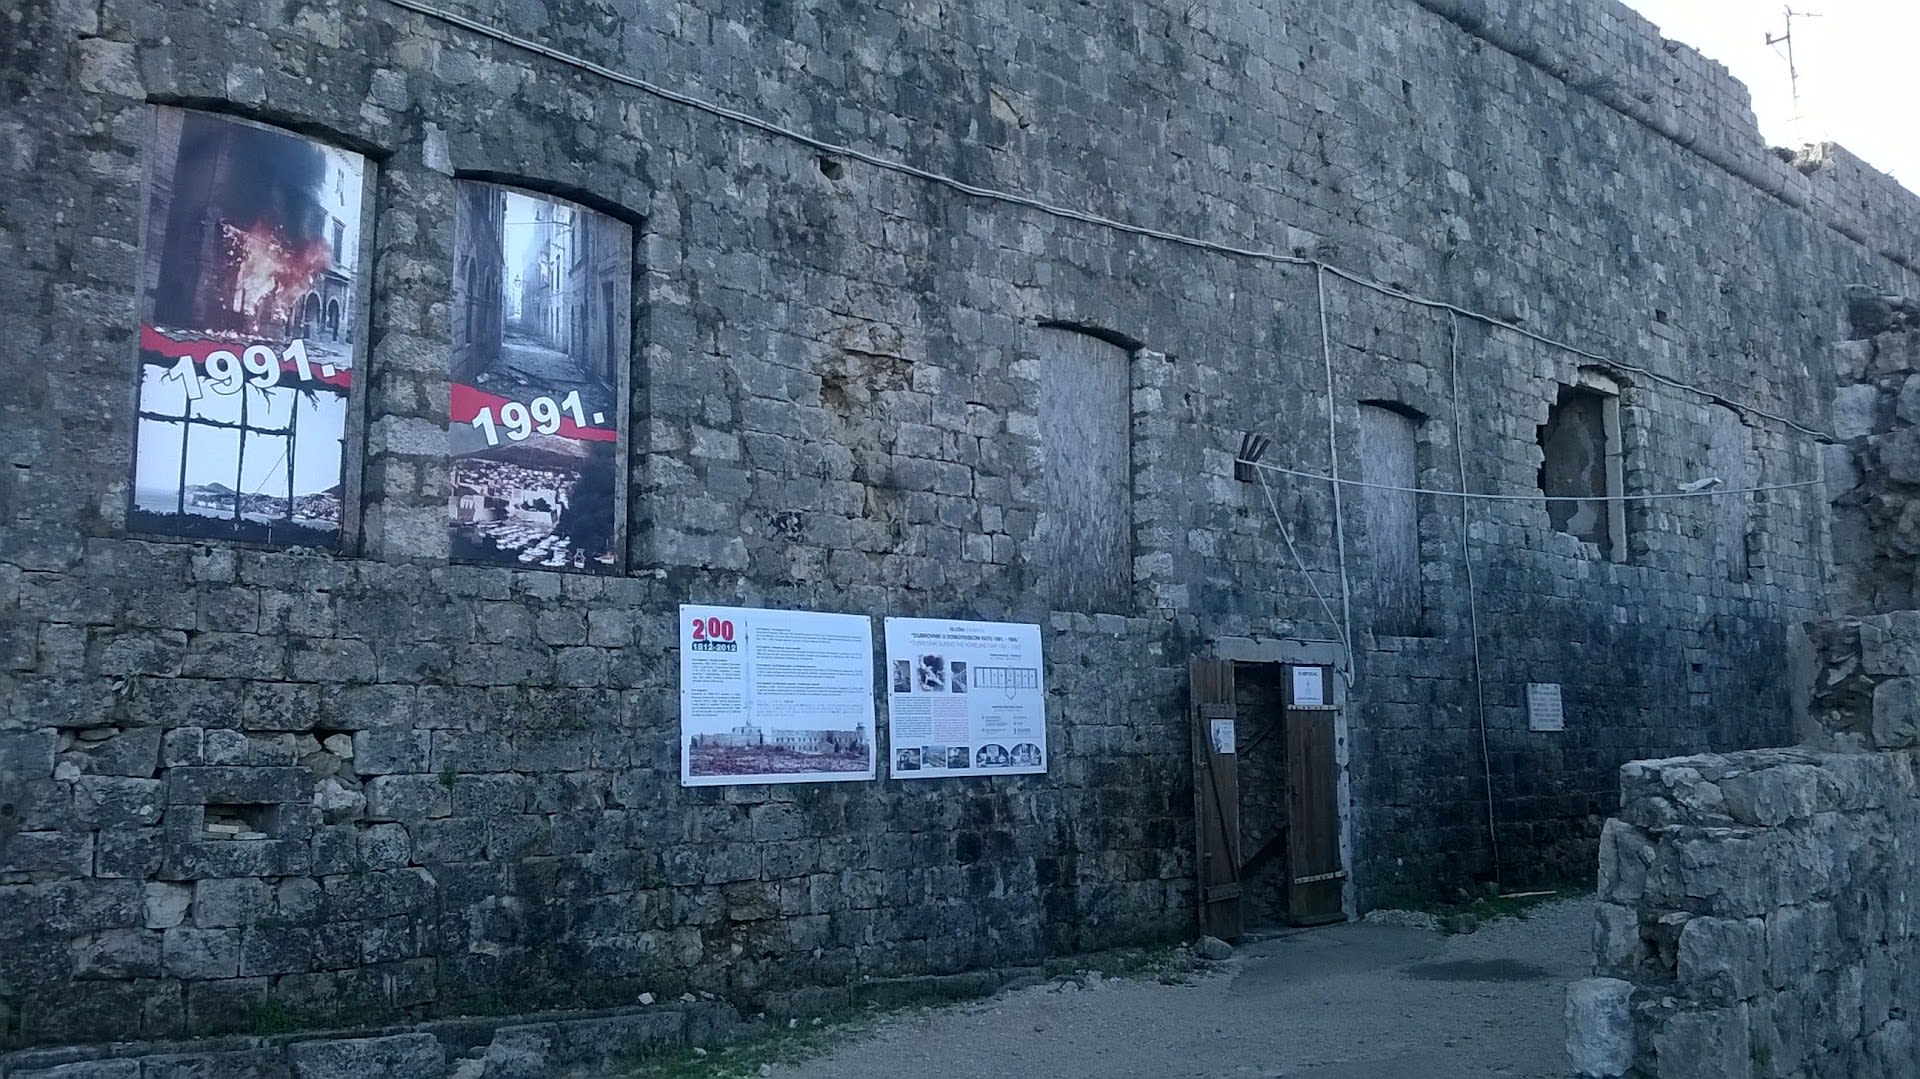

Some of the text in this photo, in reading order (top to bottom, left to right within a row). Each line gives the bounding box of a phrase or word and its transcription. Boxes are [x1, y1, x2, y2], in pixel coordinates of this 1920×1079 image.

[168, 339, 335, 400] 1991.
[472, 390, 605, 446] 1991.
[692, 617, 734, 641] 200
[693, 642, 736, 652] 1812-2012
